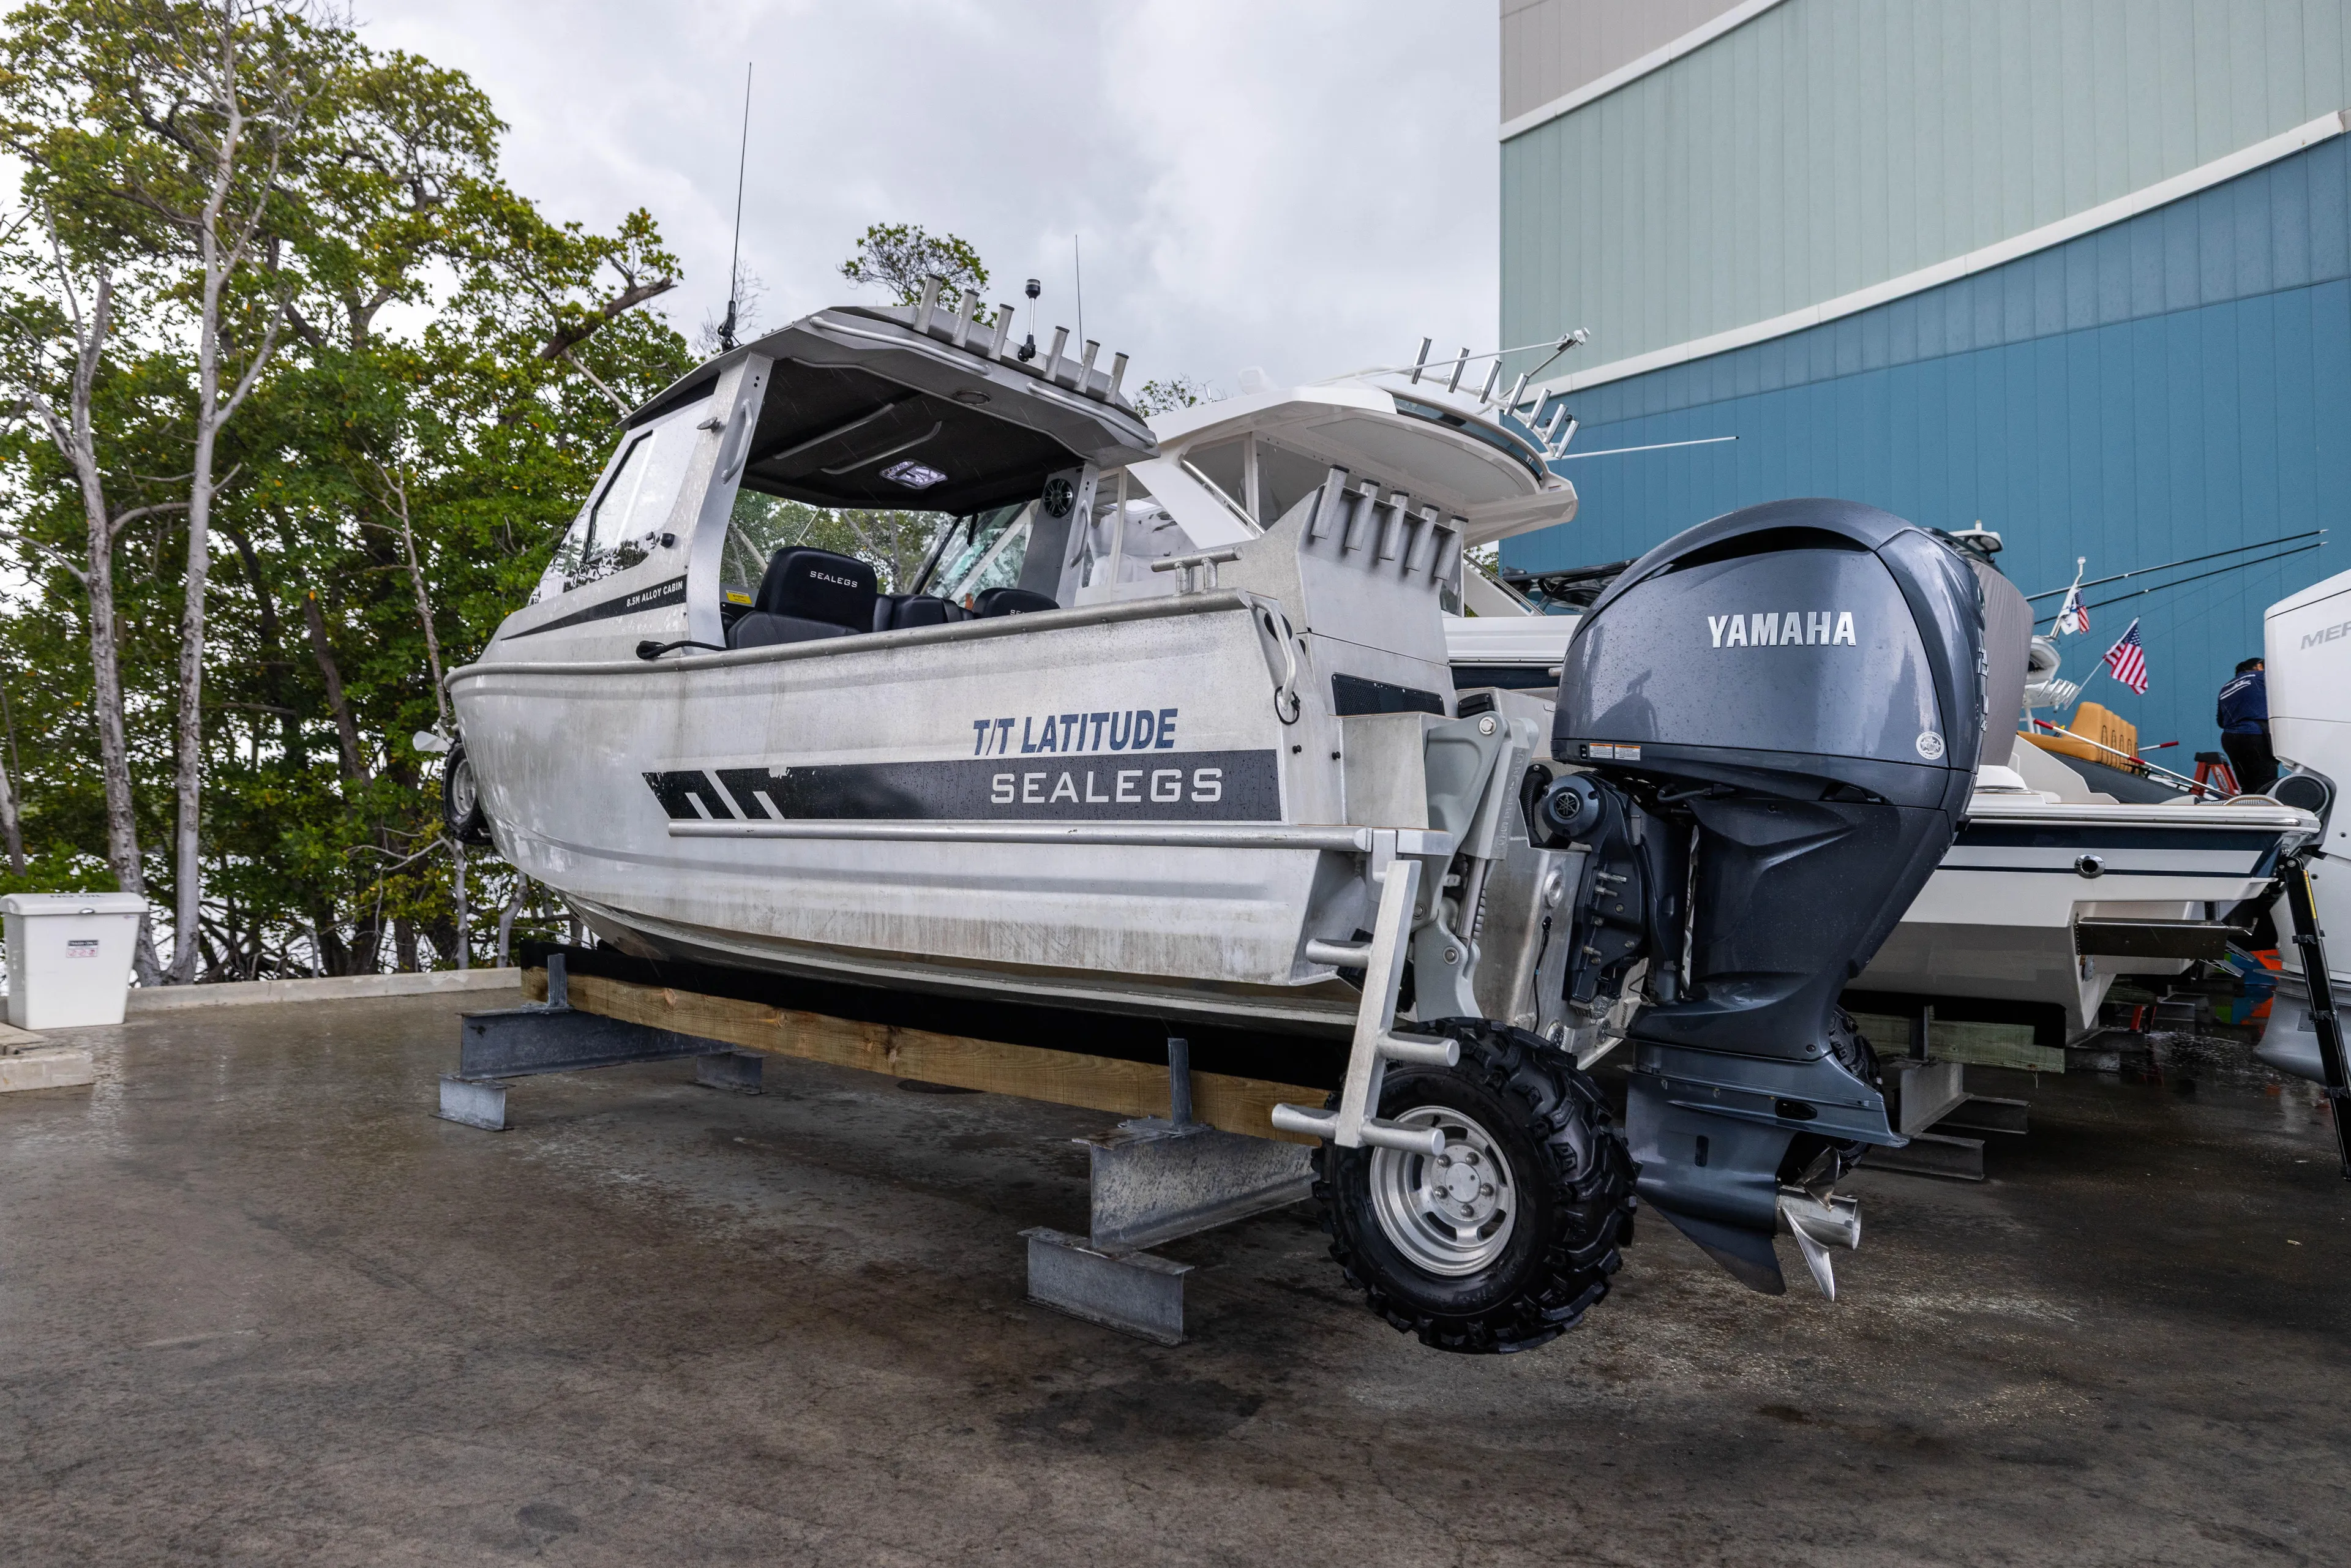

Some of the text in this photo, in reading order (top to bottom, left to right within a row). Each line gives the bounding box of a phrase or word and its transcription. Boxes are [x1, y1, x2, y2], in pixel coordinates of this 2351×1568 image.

[626, 580, 683, 607] 8.5M ALLOY CABIN
[810, 571, 858, 588] SEALEGS
[1708, 611, 1857, 648] YAMAHA
[973, 708, 1179, 756] T/T LATITUDE
[990, 768, 1223, 804] SEALEGS
